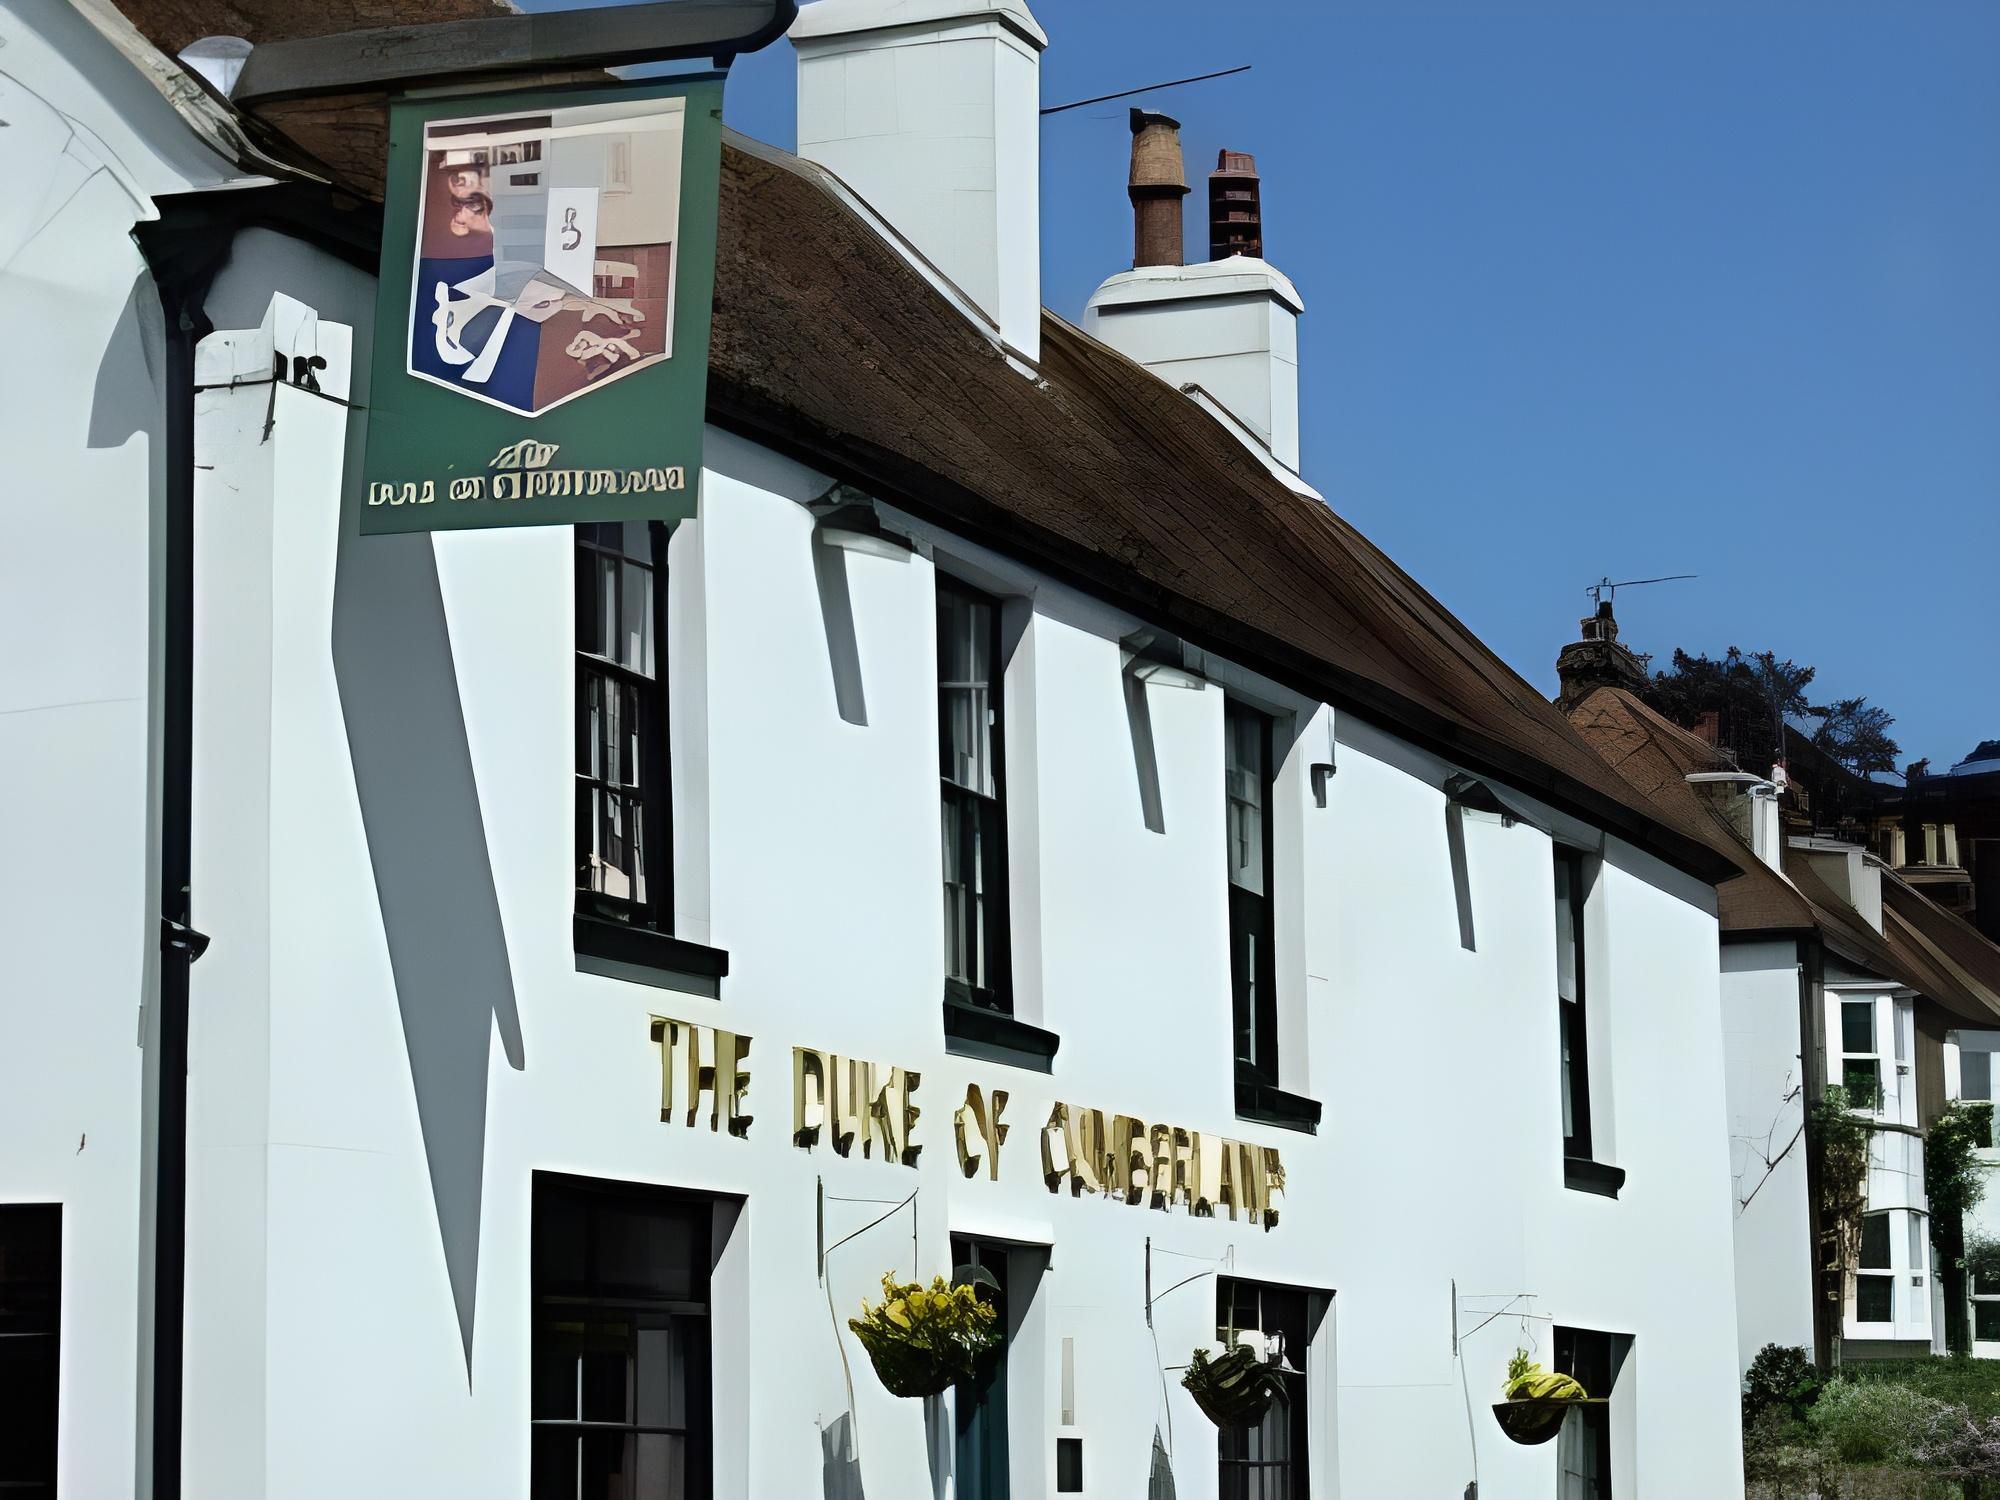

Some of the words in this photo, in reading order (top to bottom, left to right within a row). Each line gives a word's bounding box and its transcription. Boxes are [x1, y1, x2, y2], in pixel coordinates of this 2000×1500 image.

[648, 1014, 754, 1140] THE
[792, 1046, 923, 1170] DUKE
[1041, 1101, 1286, 1233] CBERLAN
